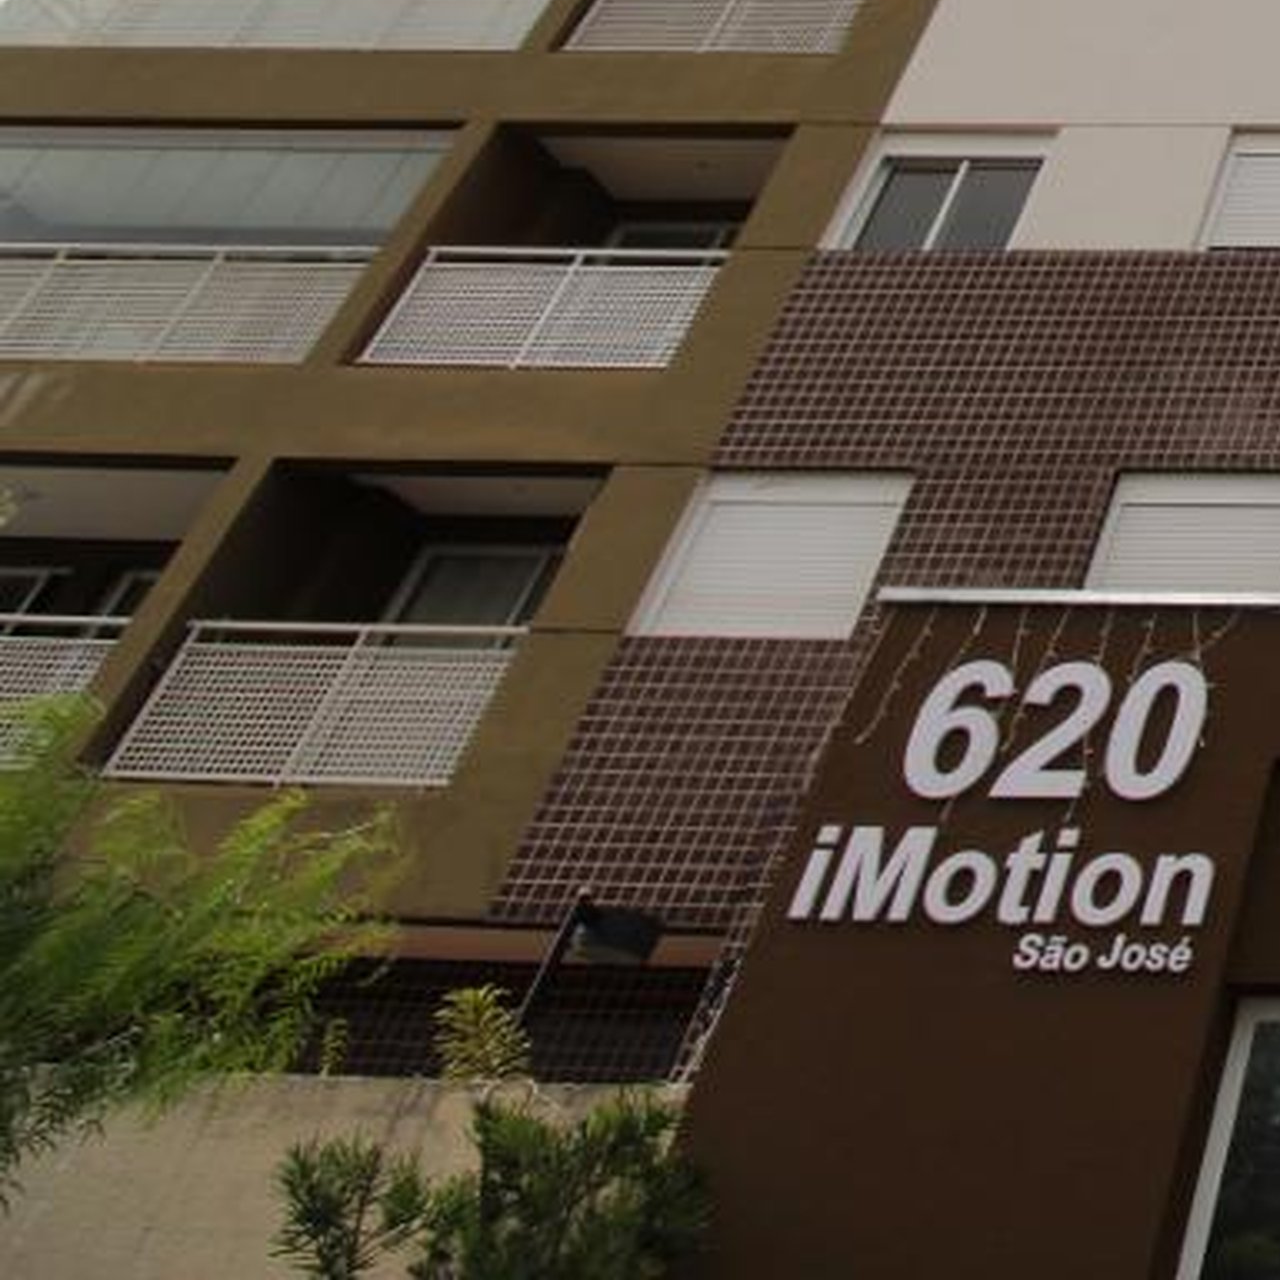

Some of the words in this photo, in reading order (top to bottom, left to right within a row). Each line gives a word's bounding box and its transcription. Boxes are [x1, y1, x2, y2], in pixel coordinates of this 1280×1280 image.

[903, 659, 1208, 801] 620
[788, 825, 1215, 926] iMotion
[1013, 933, 1090, 971] São
[1097, 933, 1193, 971] José
